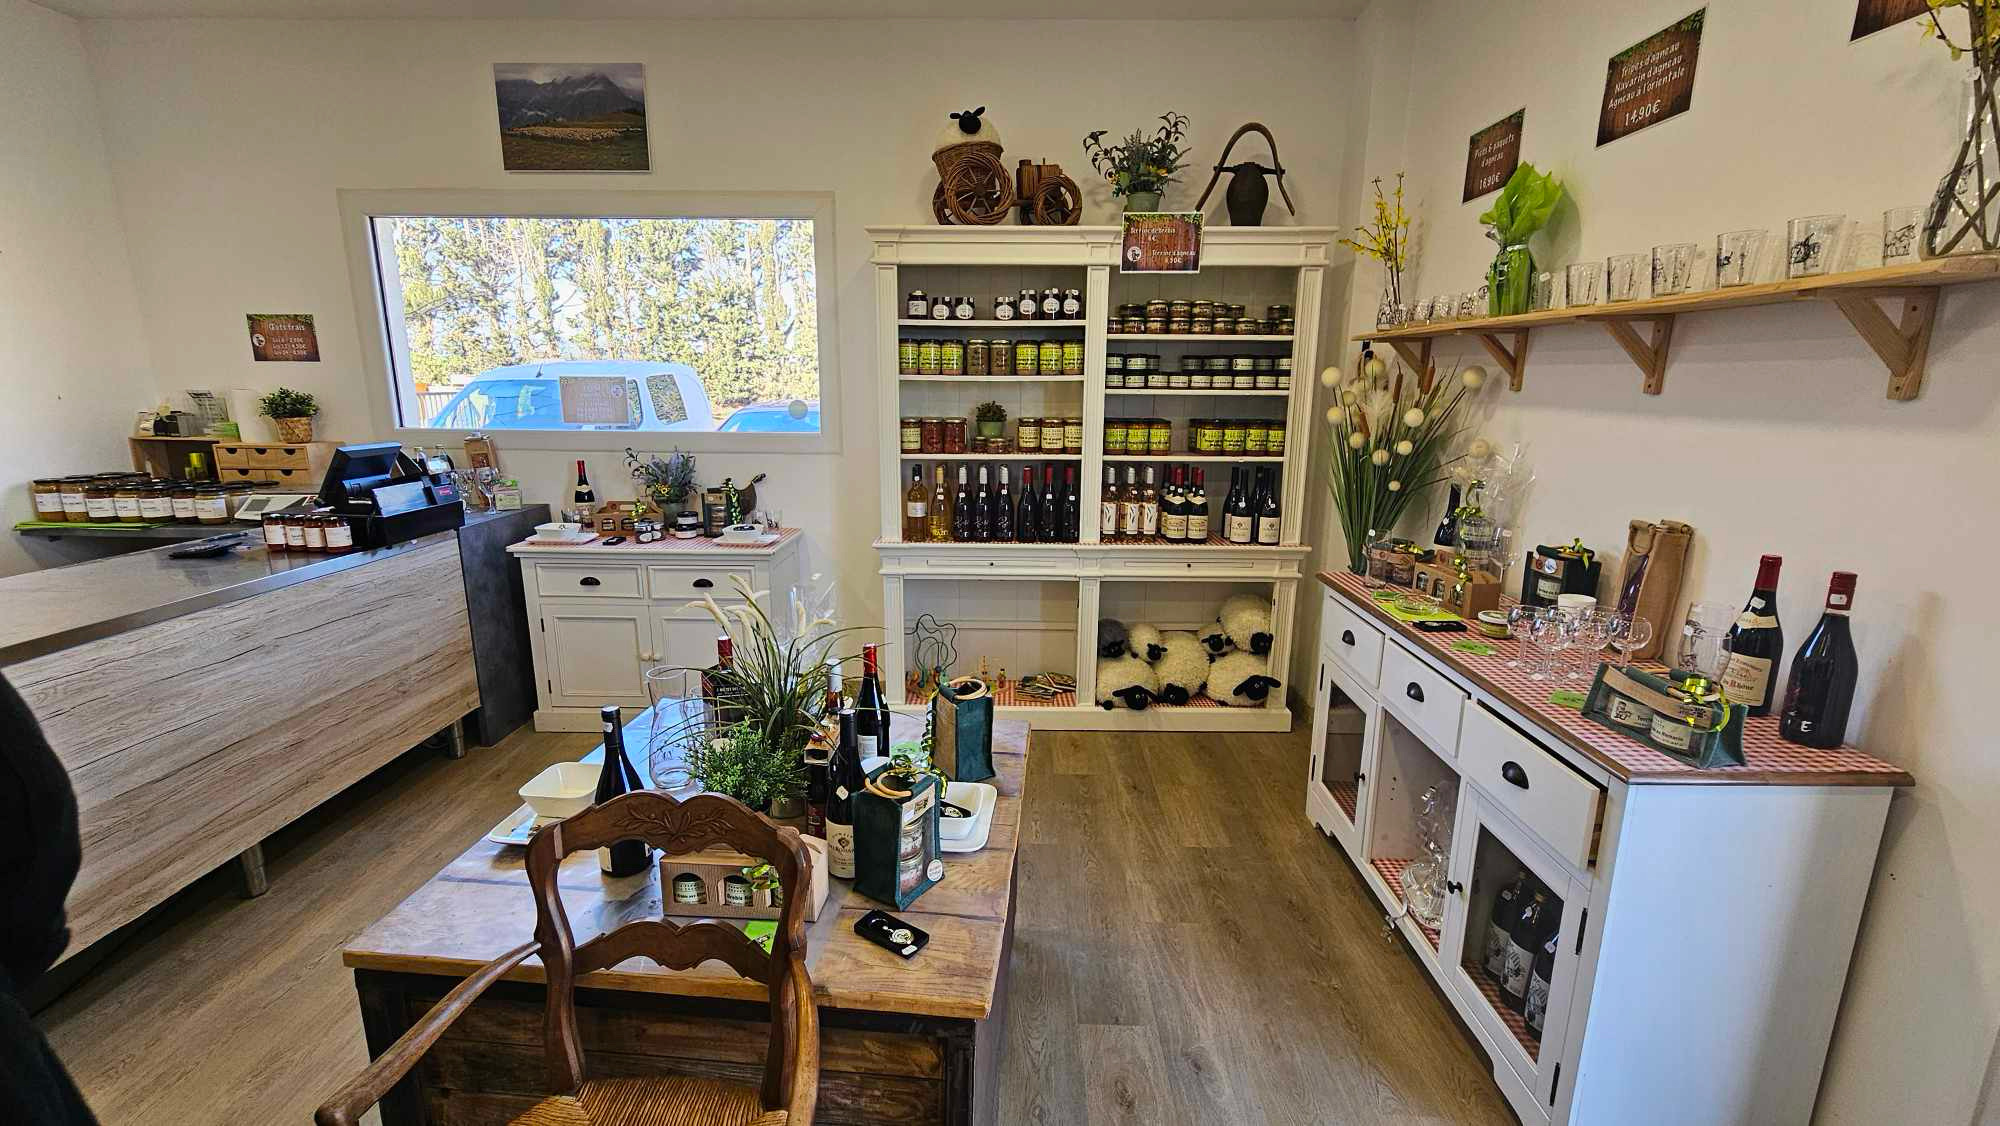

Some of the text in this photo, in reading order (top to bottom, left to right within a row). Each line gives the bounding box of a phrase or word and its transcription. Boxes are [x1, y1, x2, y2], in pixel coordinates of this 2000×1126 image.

[1615, 55, 1682, 94] Navarin d'agneau
[1608, 92, 1635, 110] Agneau
[1625, 99, 1661, 126] 14,90€
